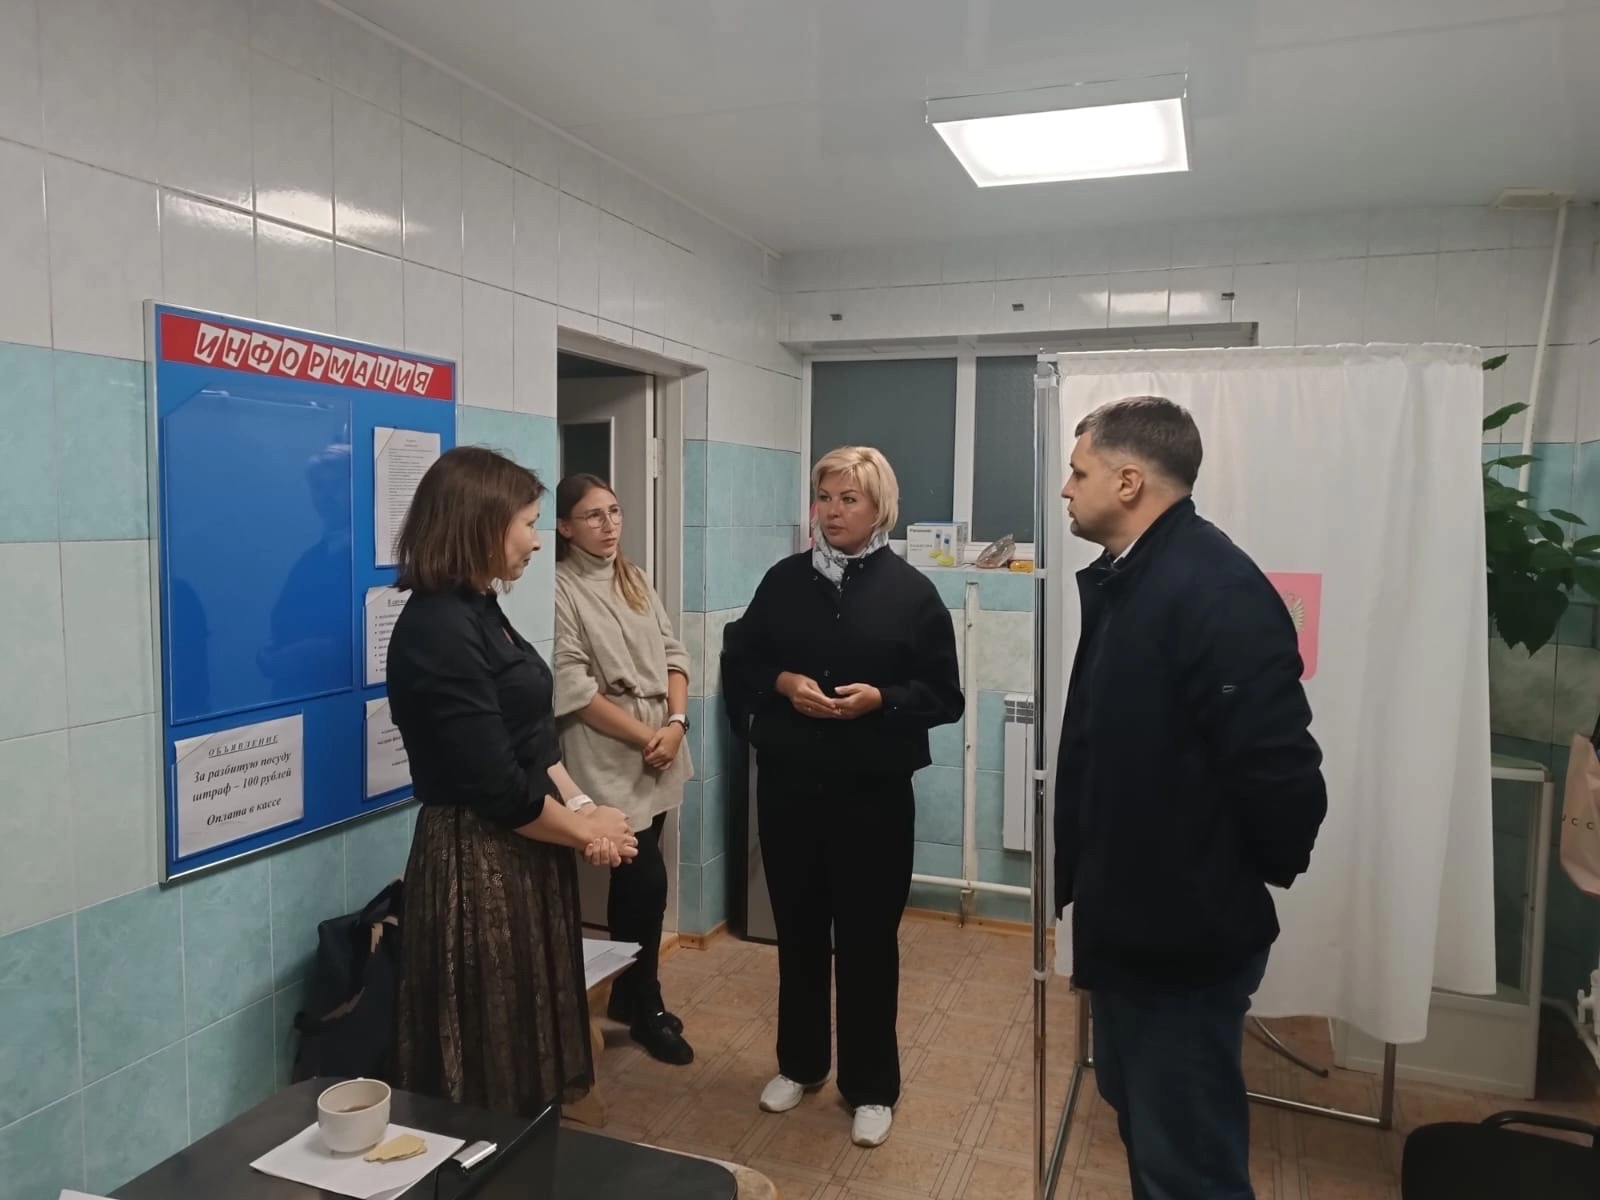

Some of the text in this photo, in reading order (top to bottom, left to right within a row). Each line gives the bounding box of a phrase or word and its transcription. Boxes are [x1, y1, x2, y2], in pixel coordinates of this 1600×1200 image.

[197, 331, 430, 394] ИНФОРМАЦИЯ
[208, 735, 278, 757] ОБЪЯВЛЕНИЕ
[194, 752, 291, 783] За разбитую посуду
[192, 782, 231, 802] штраф
[243, 775, 259, 789] 100
[260, 768, 292, 787] рублей
[207, 807, 247, 825] Оплата
[256, 797, 282, 811] кассе
